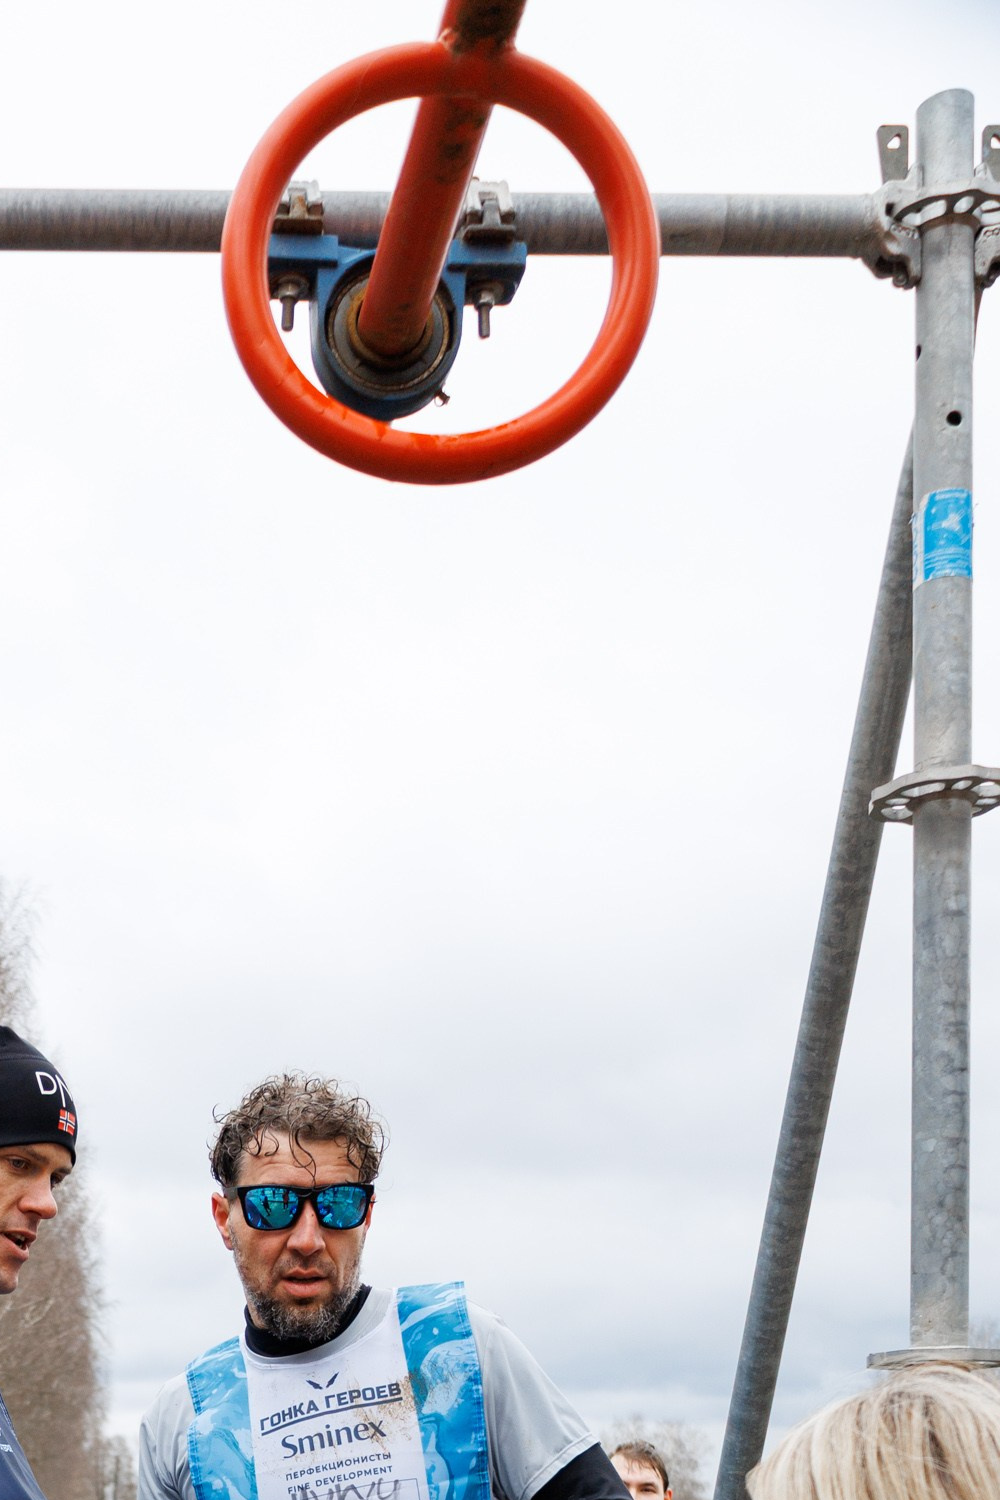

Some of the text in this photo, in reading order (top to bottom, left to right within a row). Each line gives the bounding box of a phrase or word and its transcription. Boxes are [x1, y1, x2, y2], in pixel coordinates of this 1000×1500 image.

[35, 1071, 73, 1108] DN
[260, 1382, 402, 1431] ГОНКА ГЕРОЕВ
[281, 1420, 387, 1459] Sminex
[285, 1452, 392, 1481] ПЕРФЕКЦИОНИСТЫ
[288, 1466, 393, 1494] FINE DEVELOPMENT
